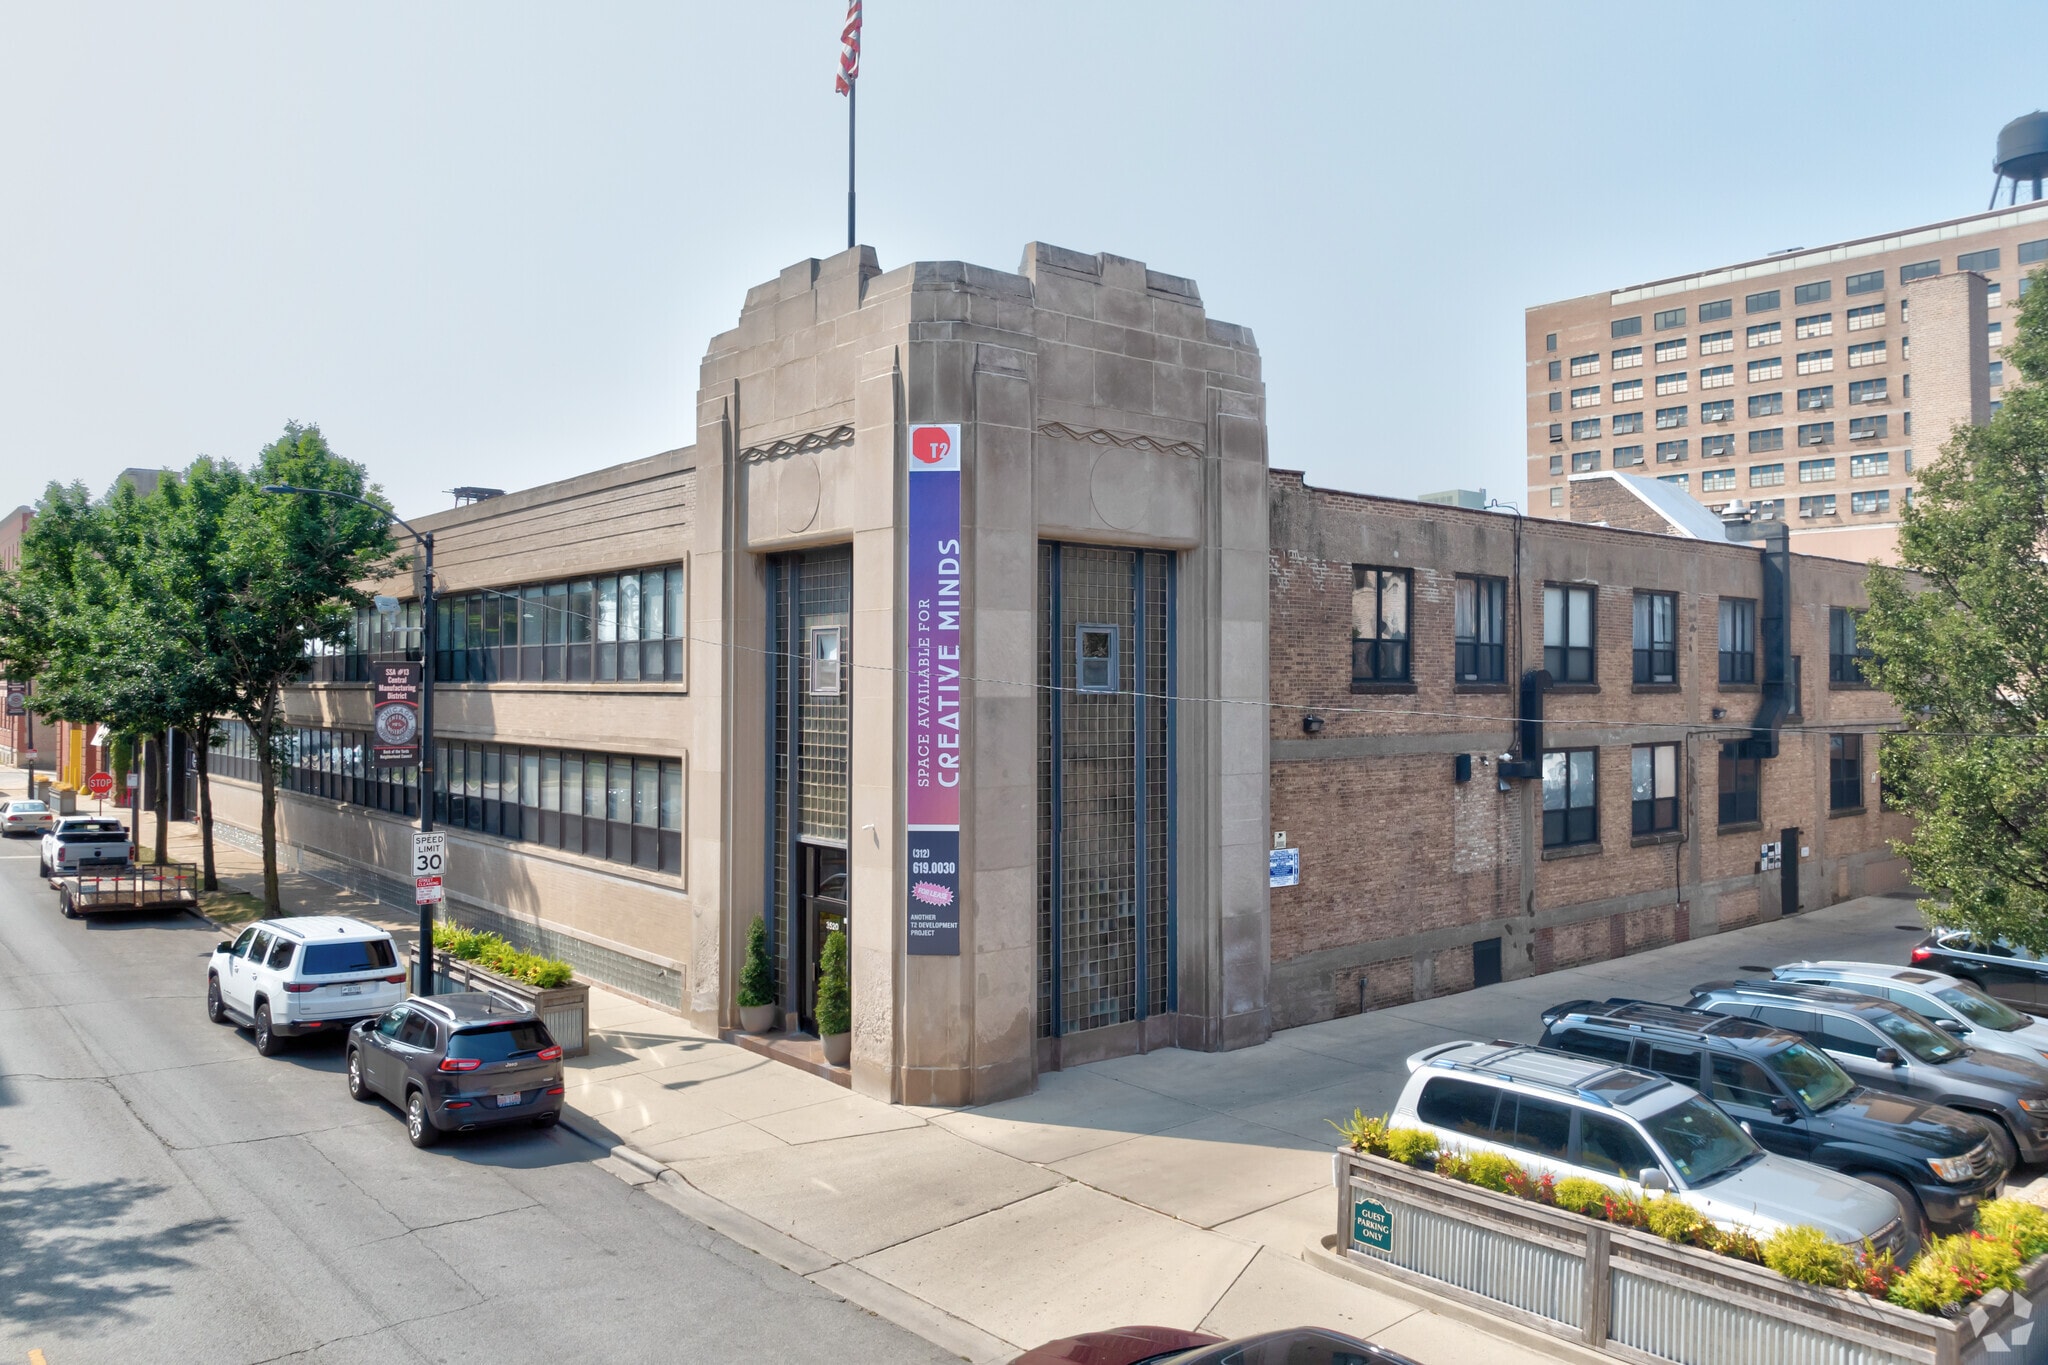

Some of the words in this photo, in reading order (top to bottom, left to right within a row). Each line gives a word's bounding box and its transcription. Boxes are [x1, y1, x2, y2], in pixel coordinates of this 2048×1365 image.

[930, 442, 949, 459] T2
[938, 539, 960, 630] MINDS
[918, 598, 930, 632] FOR
[378, 684, 417, 693] Manufacturing
[918, 637, 930, 729] AVAILABLE
[380, 707, 414, 721] CHICAGO
[938, 645, 960, 788] CREATIVE
[917, 734, 930, 787] SPACE
[90, 778, 112, 788] STOP
[415, 836, 444, 845] SPEED
[418, 845, 440, 853] LIMIT
[912, 848, 930, 859] (312)
[417, 854, 442, 871] 30
[912, 861, 956, 874] 619.0030
[1362, 1209, 1385, 1222] GUEST
[1357, 1217, 1389, 1234] PARKING
[1362, 1228, 1383, 1241] ONLY
